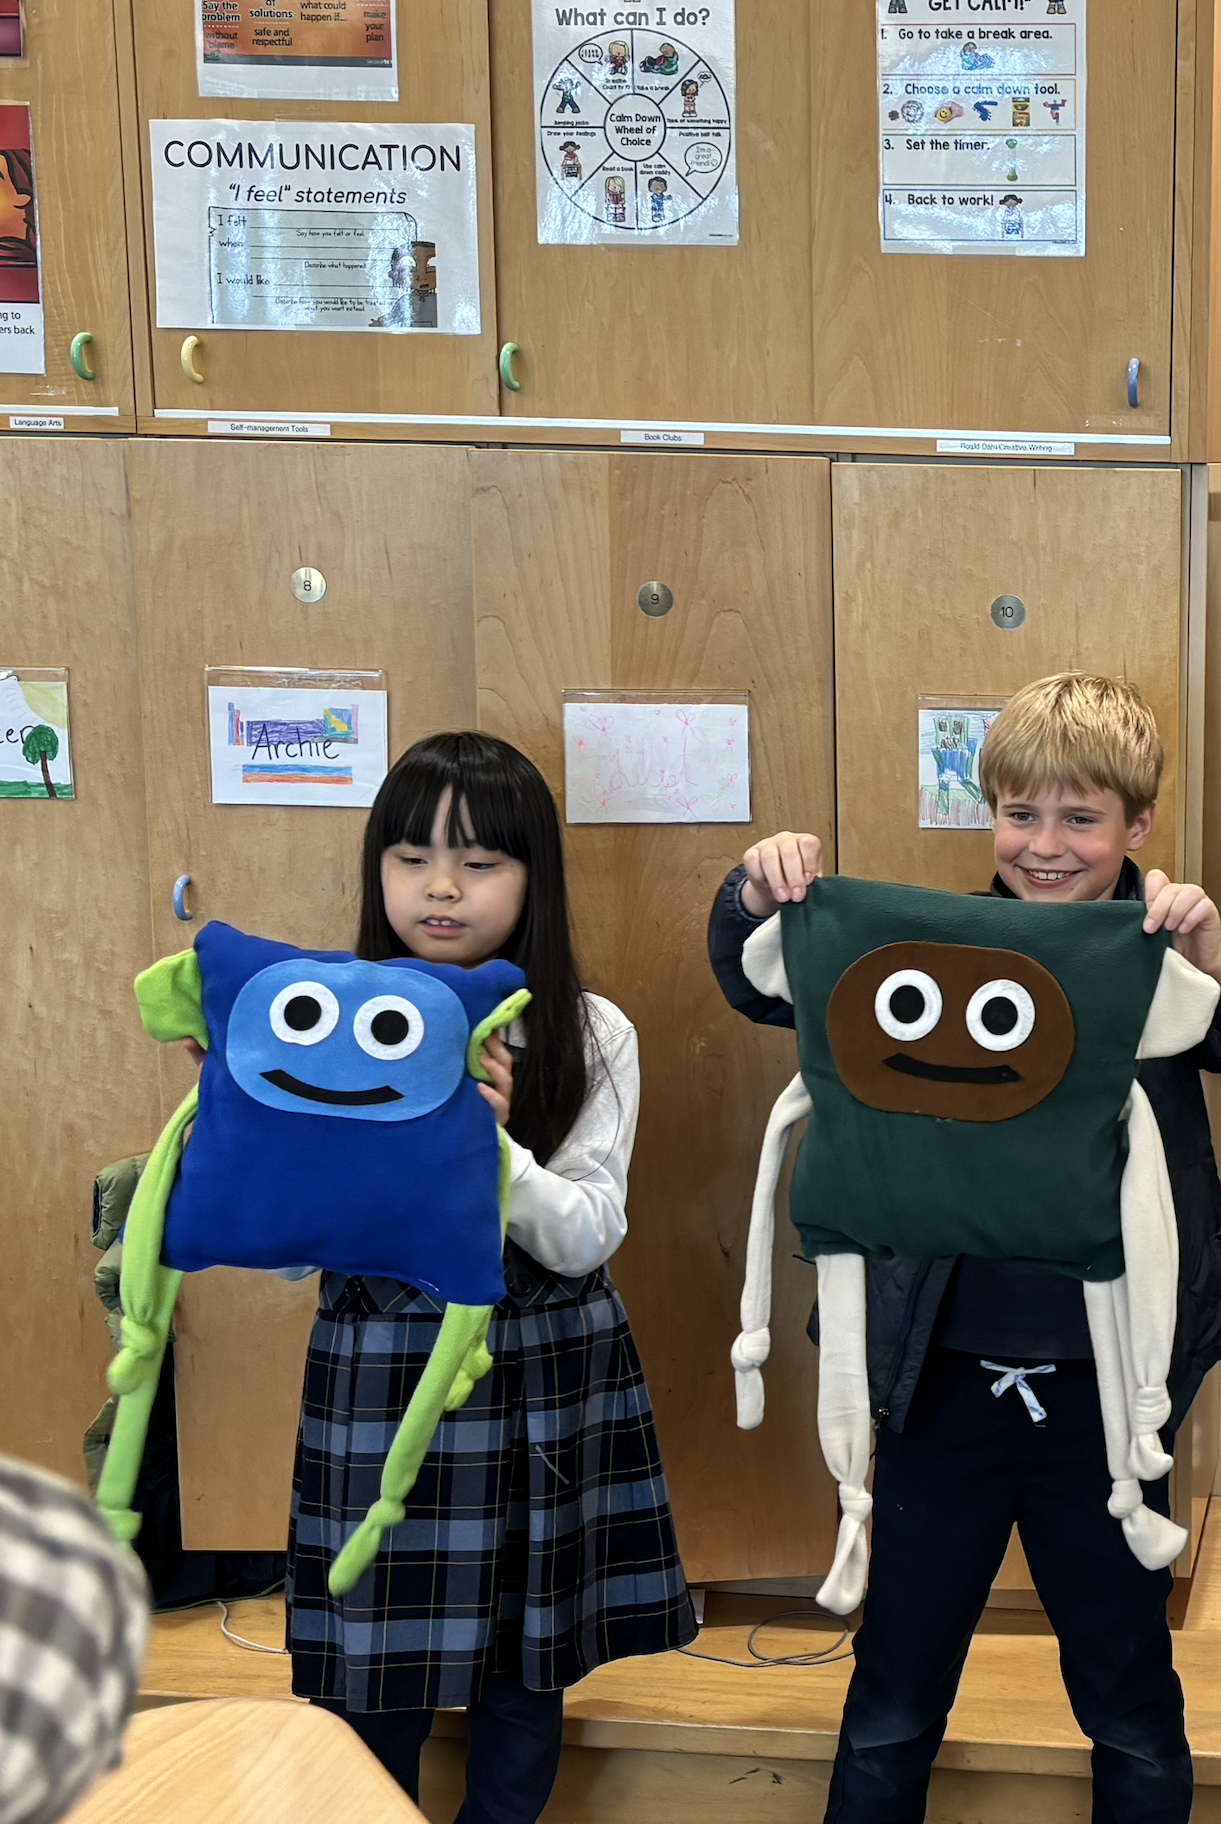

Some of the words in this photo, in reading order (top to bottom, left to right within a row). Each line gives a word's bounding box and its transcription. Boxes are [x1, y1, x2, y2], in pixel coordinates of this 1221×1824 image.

[202, 1, 219, 11] Say
[222, 1, 238, 10] the
[300, 1, 322, 9] what
[324, 1, 346, 9] could
[249, 9, 293, 18] solutions
[300, 12, 332, 23] happen
[363, 10, 386, 19] make
[555, 8, 607, 26] What
[613, 11, 649, 26] can
[656, 7, 667, 25] I
[673, 8, 711, 26] do?
[254, 27, 271, 36] safe
[274, 28, 290, 36] and
[365, 23, 384, 31] your
[366, 33, 384, 43] plan
[898, 29, 915, 41] Go
[918, 28, 931, 40] to
[935, 28, 963, 40] take
[967, 30, 975, 40] a
[978, 28, 1016, 40] break
[1019, 29, 1053, 40] area.
[252, 38, 293, 47] respectful
[882, 84, 893, 95] 2.
[904, 83, 949, 95] Choose
[952, 85, 960, 95] a
[964, 84, 993, 95] calm
[997, 84, 1030, 95] down
[1034, 83, 1060, 95] tool.
[609, 113, 634, 123] Calm
[635, 114, 661, 123] Down
[615, 126, 643, 134] Wheel
[646, 125, 657, 134] of
[621, 137, 651, 146] Choice
[883, 139, 894, 150] 3.
[905, 139, 925, 150] Set
[929, 139, 950, 150] the
[953, 139, 990, 151] timer.
[163, 140, 461, 172] COMMUNICATION
[295, 188, 407, 204] statements
[884, 194, 896, 205] 4.
[907, 194, 938, 205] Back
[941, 194, 955, 205] to
[958, 194, 994, 206] work!
[217, 215, 223, 226] I
[227, 215, 247, 226] felt
[219, 240, 244, 248] when
[217, 273, 223, 284] I
[226, 273, 253, 285] would
[256, 274, 270, 285] like
[14, 325, 35, 334] back
[14, 419, 46, 427] Language
[230, 424, 289, 433] Self-management
[303, 580, 312, 592] 8
[650, 593, 659, 605] 9
[1000, 606, 1014, 619] 10
[251, 723, 340, 761] Archie
